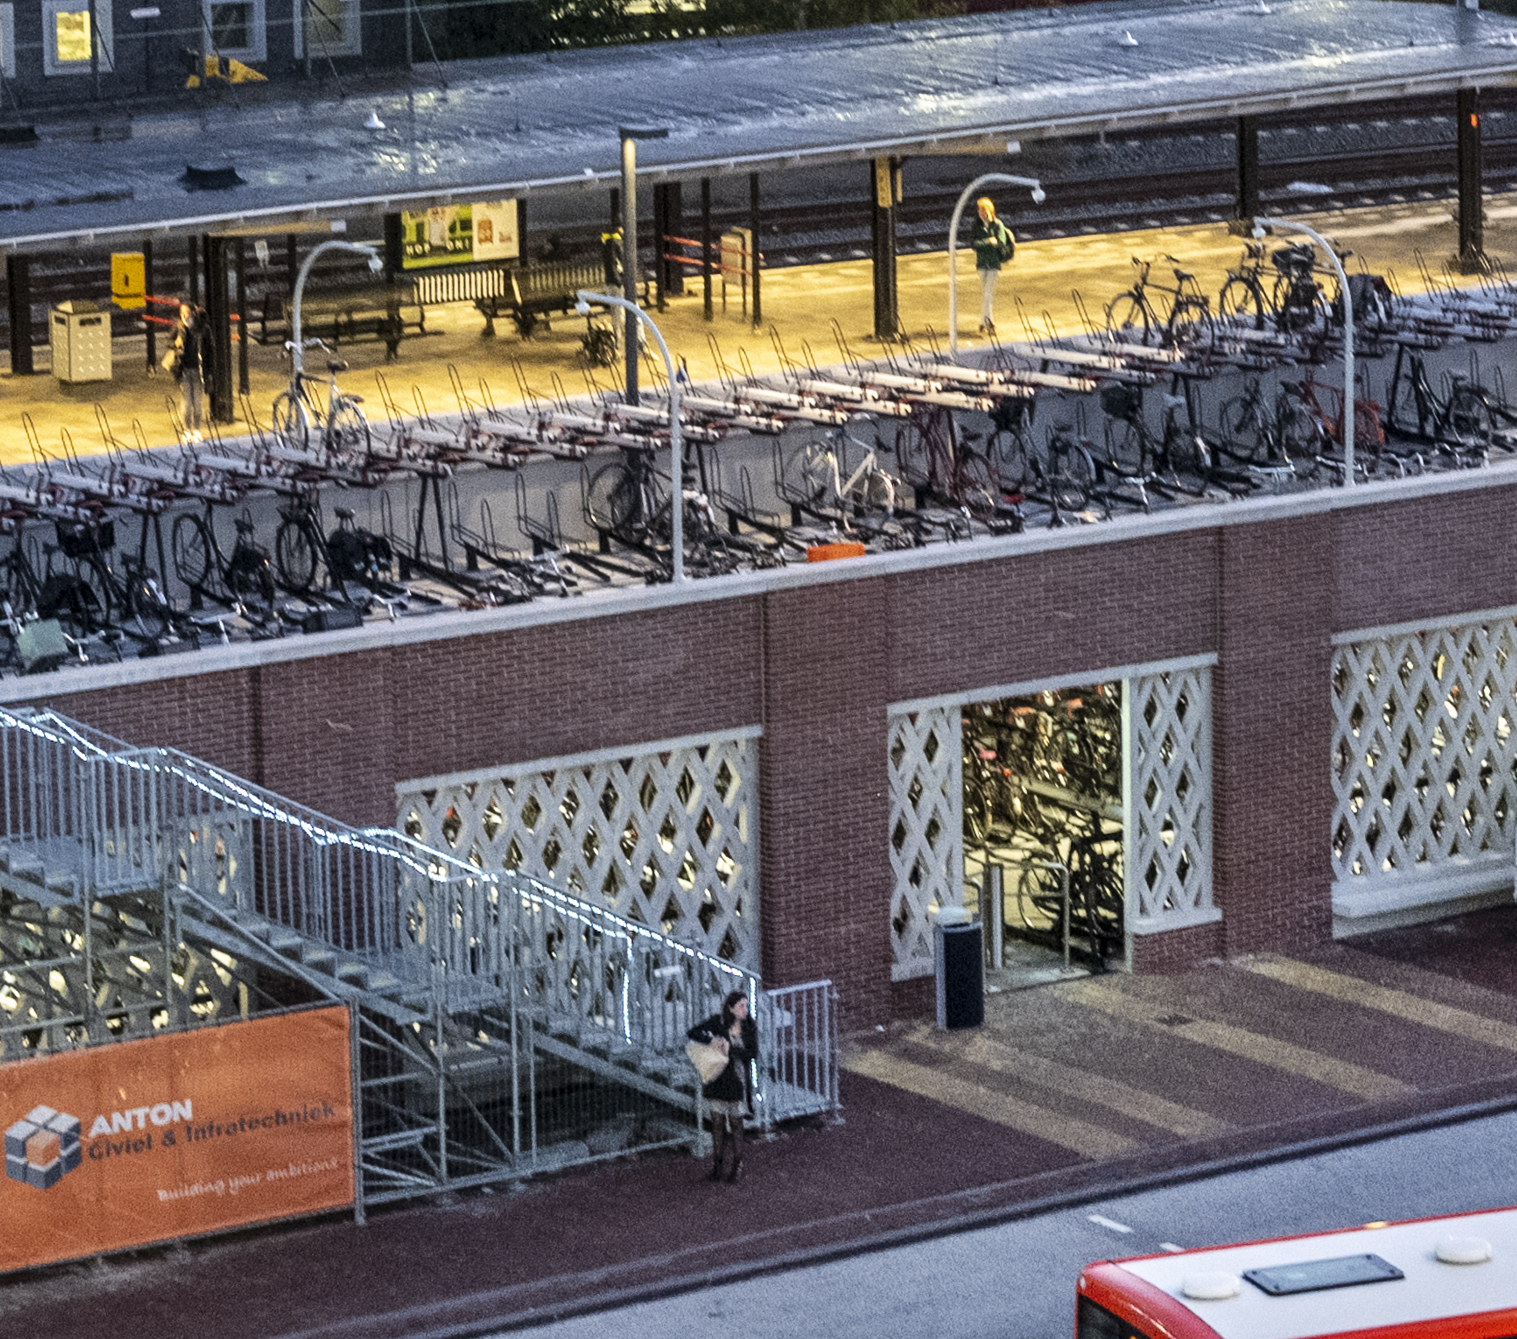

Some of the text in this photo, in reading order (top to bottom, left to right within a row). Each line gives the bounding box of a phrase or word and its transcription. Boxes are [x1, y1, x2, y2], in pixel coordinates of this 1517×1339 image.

[88, 1099, 193, 1138] ANTON
[88, 1101, 335, 1160] Civiel & Infratechniek
[157, 1158, 339, 1202] Building your ambitions
